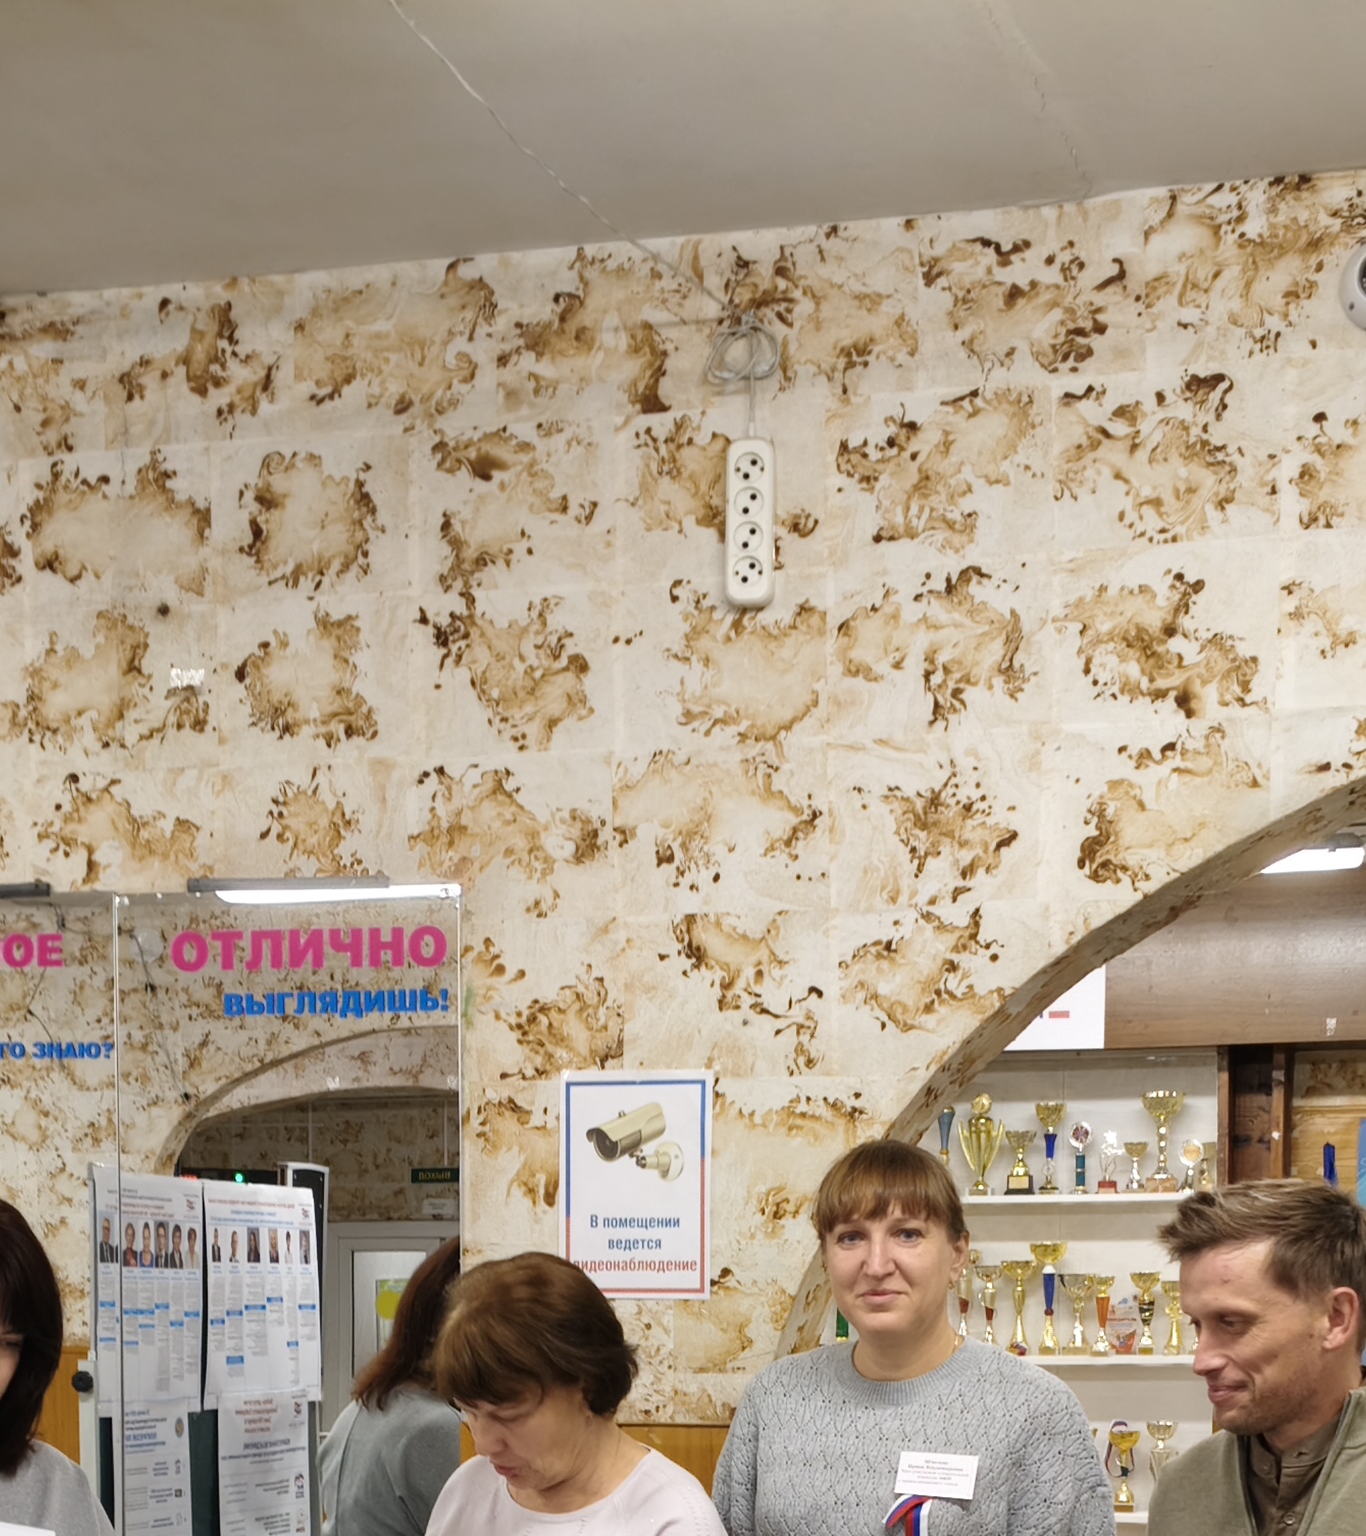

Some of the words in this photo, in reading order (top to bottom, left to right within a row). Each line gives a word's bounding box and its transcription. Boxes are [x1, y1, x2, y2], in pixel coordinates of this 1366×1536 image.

[171, 925, 447, 972] ОТЛИЧНО
[223, 988, 450, 1019] ВЫГЛЯДИШЬ!
[32, 1042, 115, 1060] ЗНАЮ?
[590, 1214, 598, 1228] В
[603, 1217, 680, 1230] помещении
[608, 1238, 662, 1252] ведется
